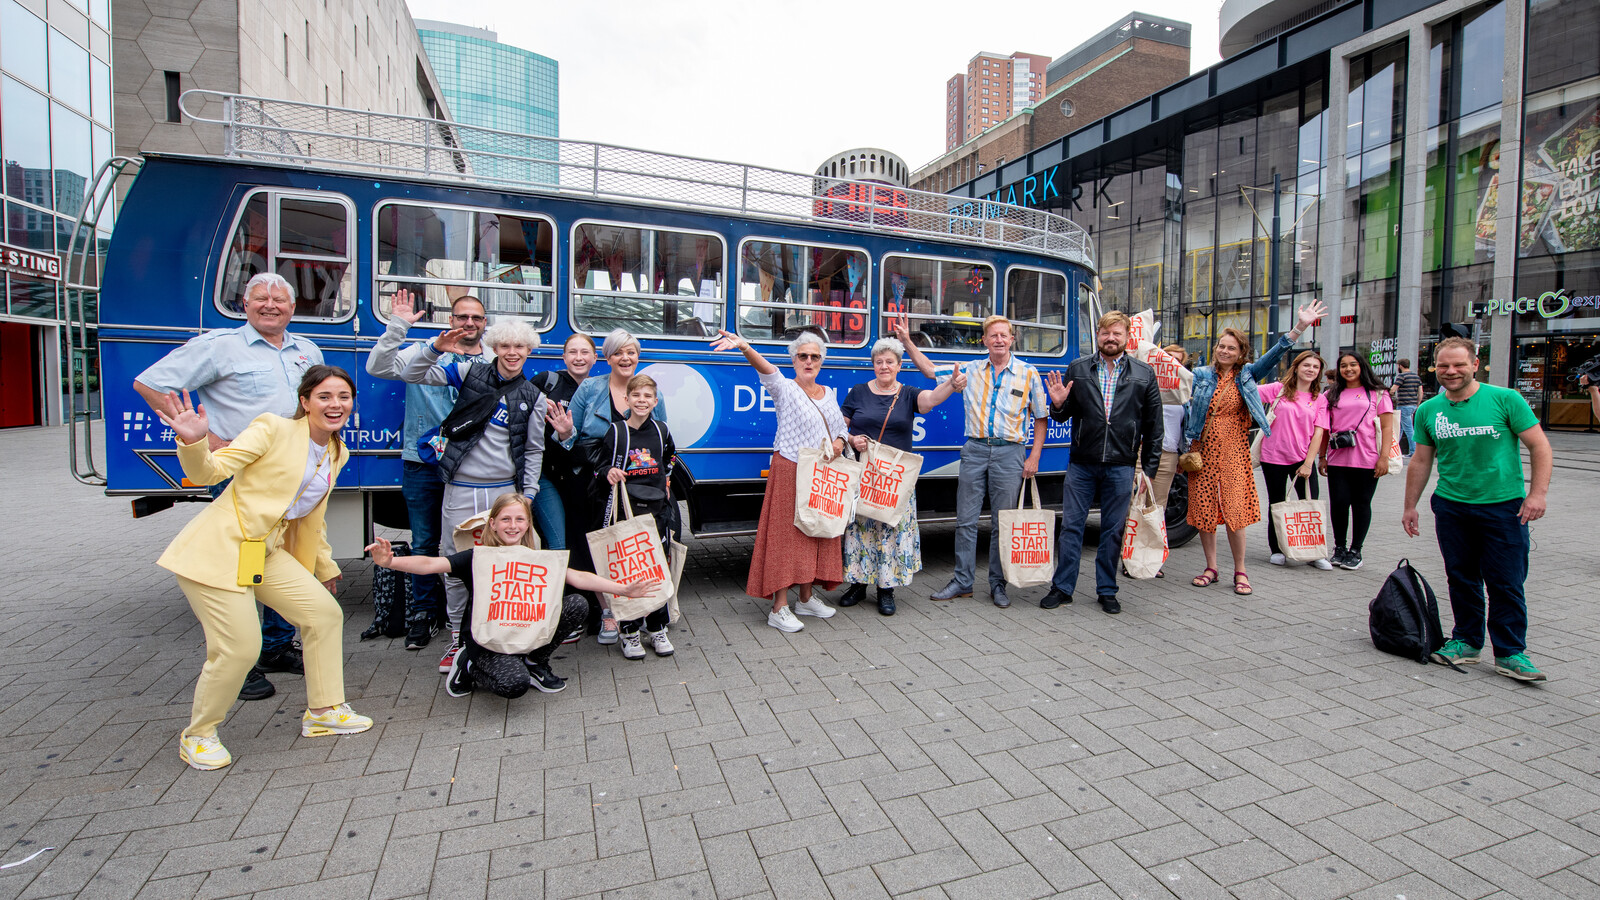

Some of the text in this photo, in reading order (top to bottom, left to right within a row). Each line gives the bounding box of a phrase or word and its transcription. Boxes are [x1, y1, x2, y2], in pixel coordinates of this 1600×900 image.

[1556, 149, 1600, 178] TAKE
[1559, 173, 1595, 199] EAT
[949, 165, 1059, 234] PRIMARK
[1558, 192, 1600, 221] LOV
[8, 250, 58, 274] STING
[628, 468, 659, 476] MPOSTOR
[813, 462, 850, 488] HIER
[861, 470, 903, 493] START
[811, 477, 847, 502] START
[808, 493, 844, 519] ROTTERDAM
[1284, 511, 1322, 524] HIER
[1012, 522, 1047, 535] HIER
[1286, 523, 1322, 535] START
[606, 531, 653, 562] HIER
[1011, 536, 1048, 550] START
[1287, 534, 1325, 547] ROTTERDAM
[608, 547, 656, 580] START
[1011, 550, 1050, 564] ROTTERDAM
[491, 561, 548, 584] HIER
[490, 581, 547, 603] START
[487, 601, 547, 622] ROTTERDAM
